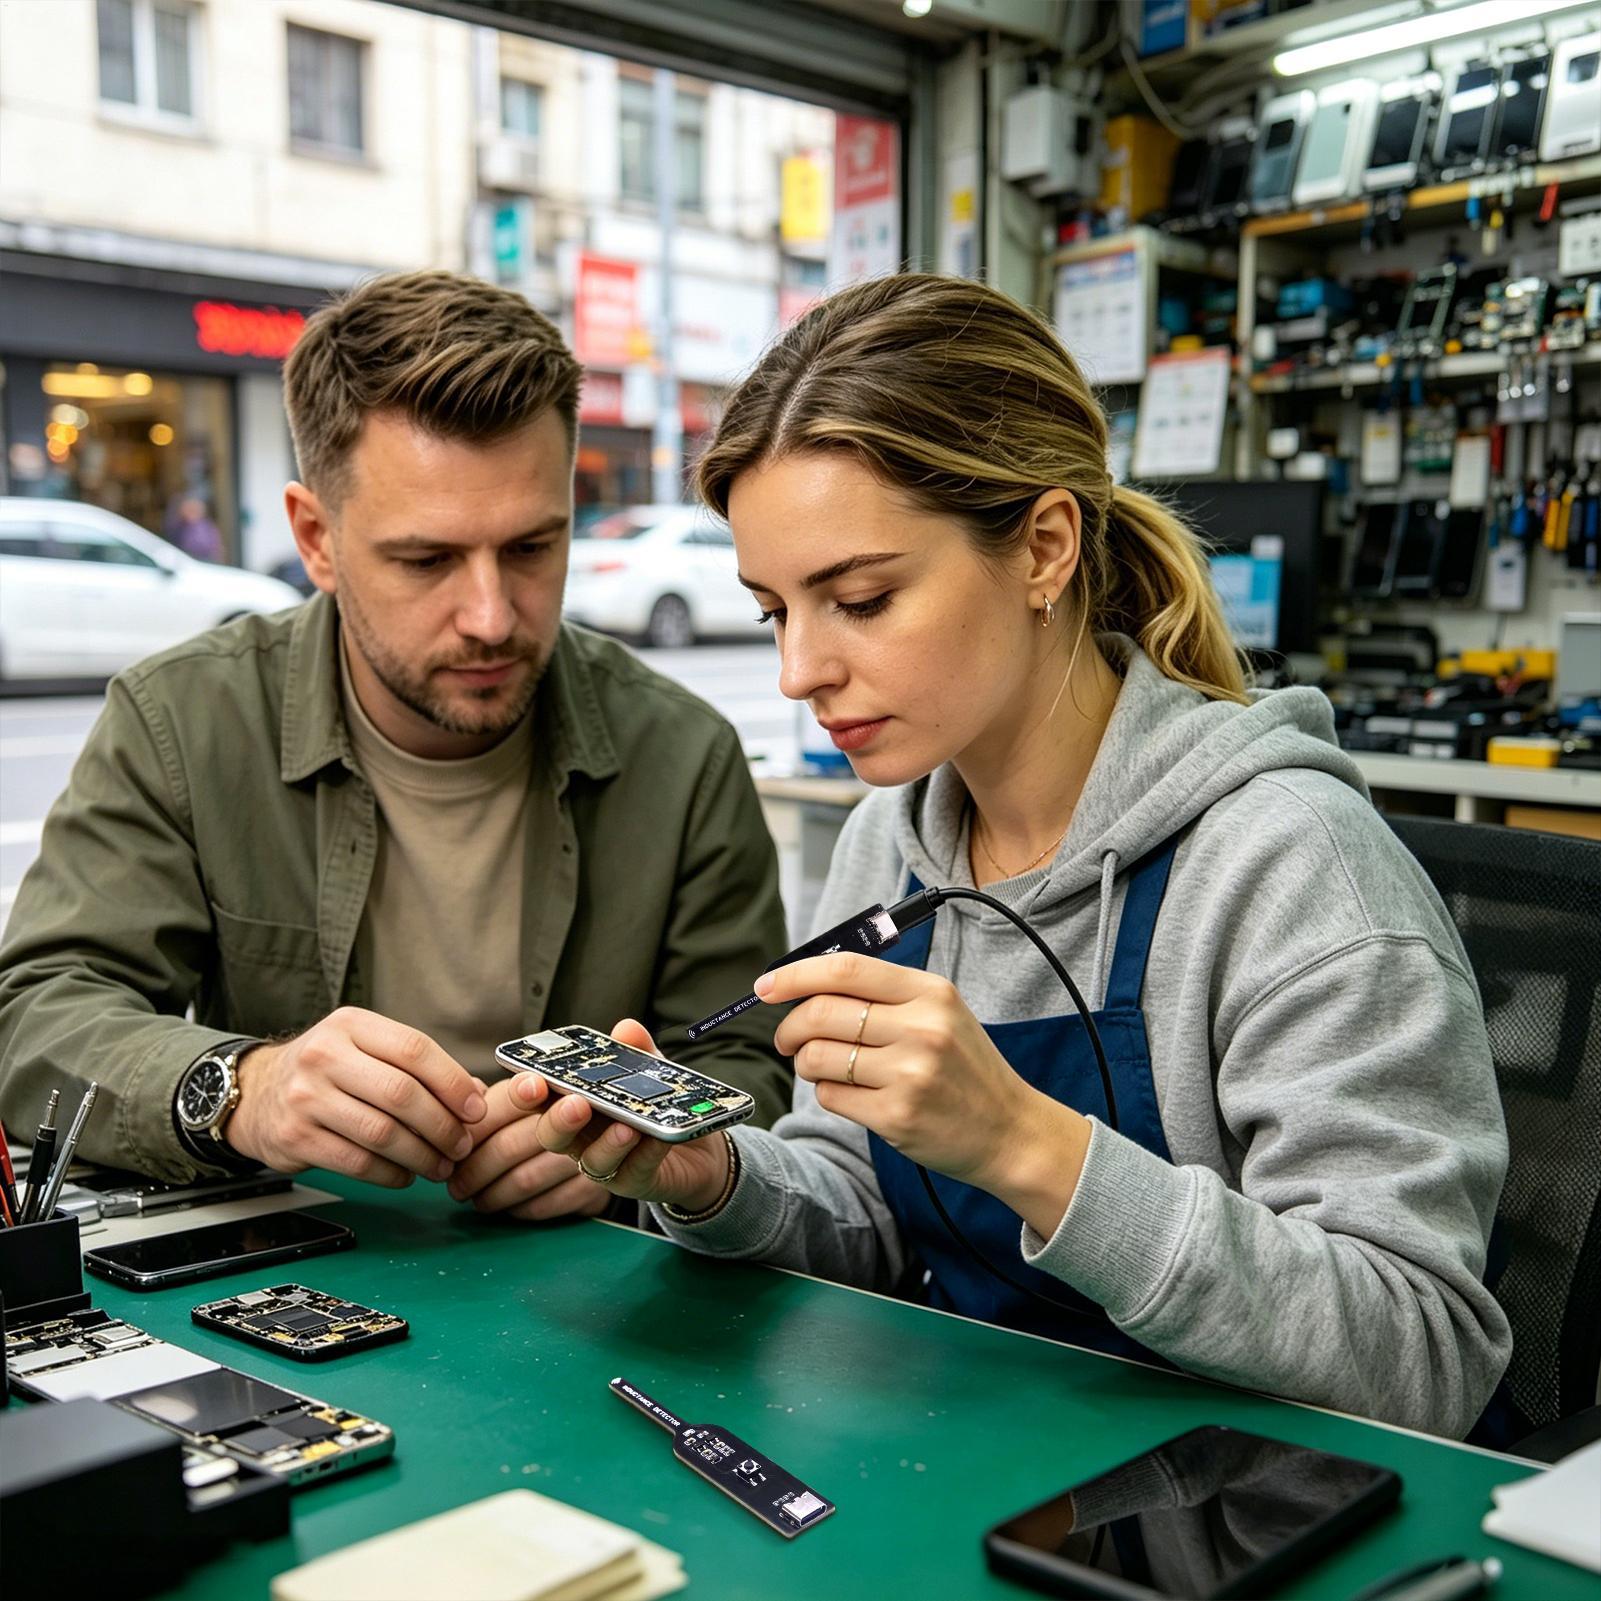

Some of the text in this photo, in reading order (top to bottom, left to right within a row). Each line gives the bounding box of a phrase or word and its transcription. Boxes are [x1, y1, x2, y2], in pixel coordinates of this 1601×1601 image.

[699, 996, 759, 1032] INDUCTANCE DETECTO
[622, 1385, 681, 1427] INDUCTANCE DETECTOR
